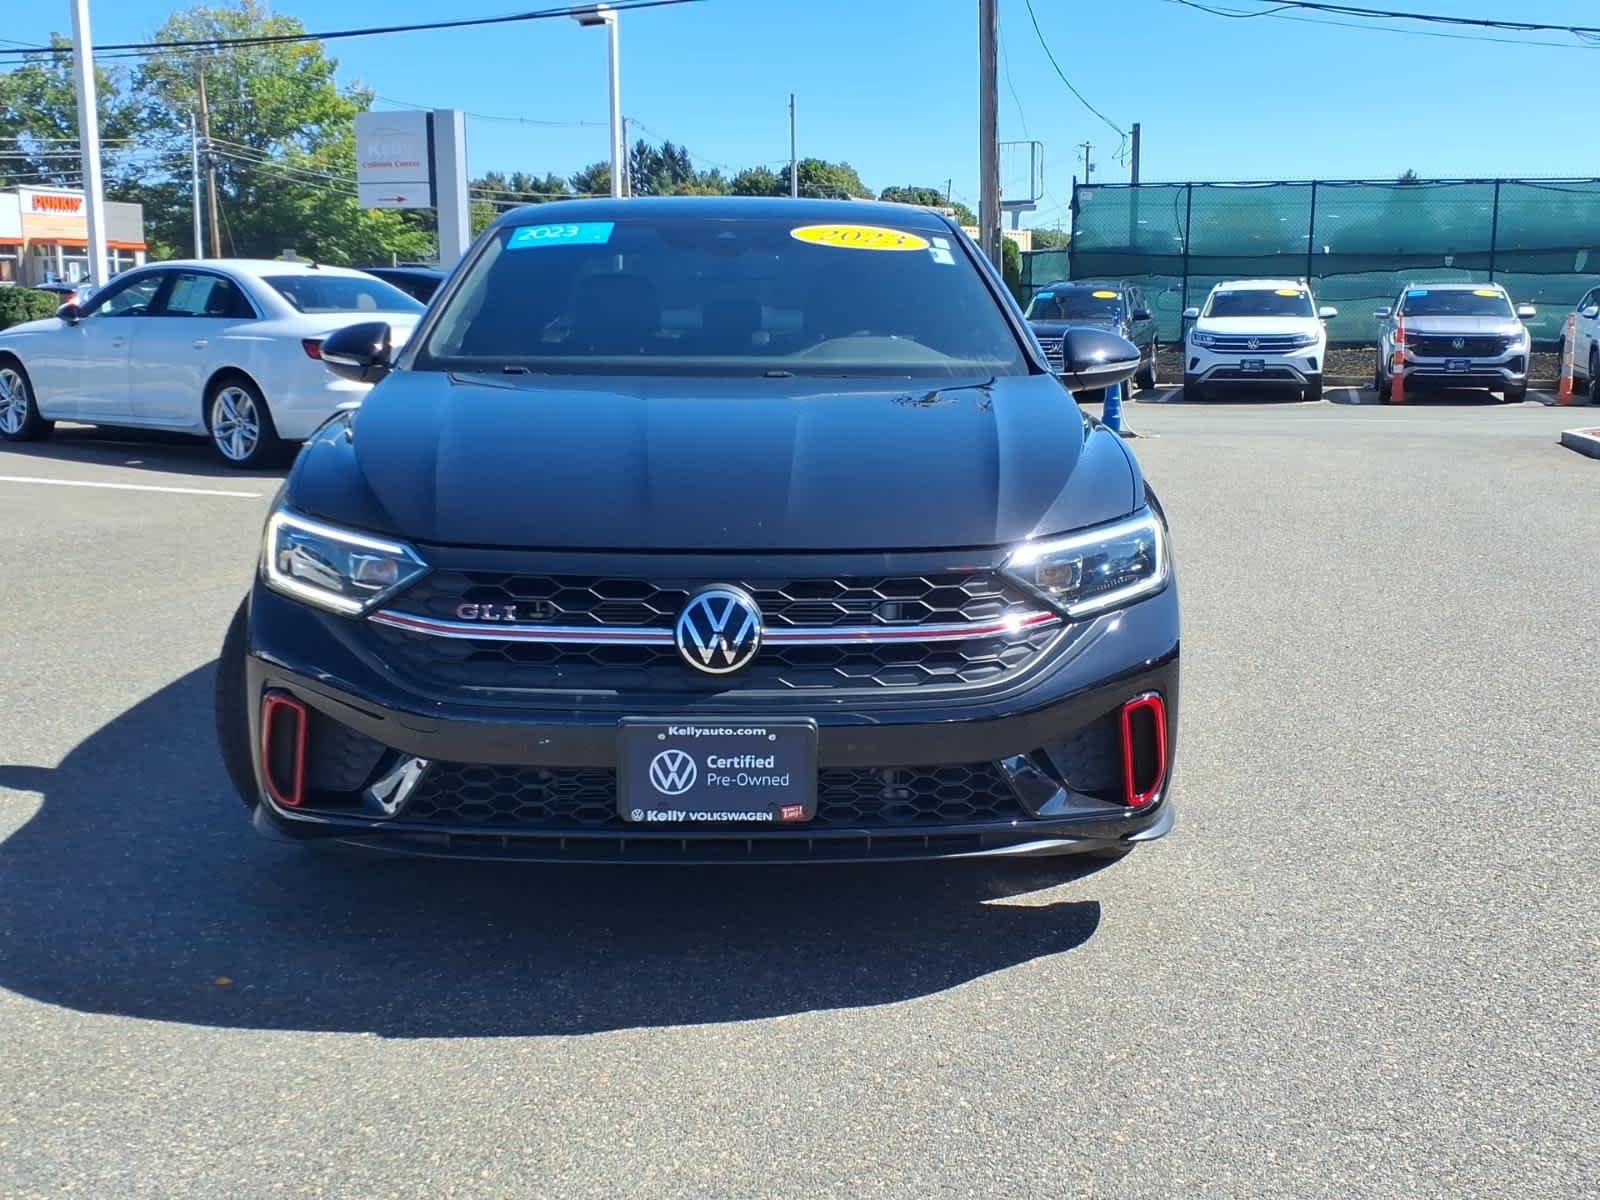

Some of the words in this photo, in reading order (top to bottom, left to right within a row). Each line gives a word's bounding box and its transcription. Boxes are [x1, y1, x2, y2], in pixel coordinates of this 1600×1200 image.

[516, 225, 579, 241] 2023
[814, 230, 907, 247] 2023
[456, 603, 516, 621] GLI
[668, 726, 767, 738] Kellyauto.com
[706, 755, 775, 769] Certified
[706, 773, 790, 787] Pre-Owned
[646, 810, 687, 822] Kelly
[688, 812, 773, 821] VOLKSWAGEN
